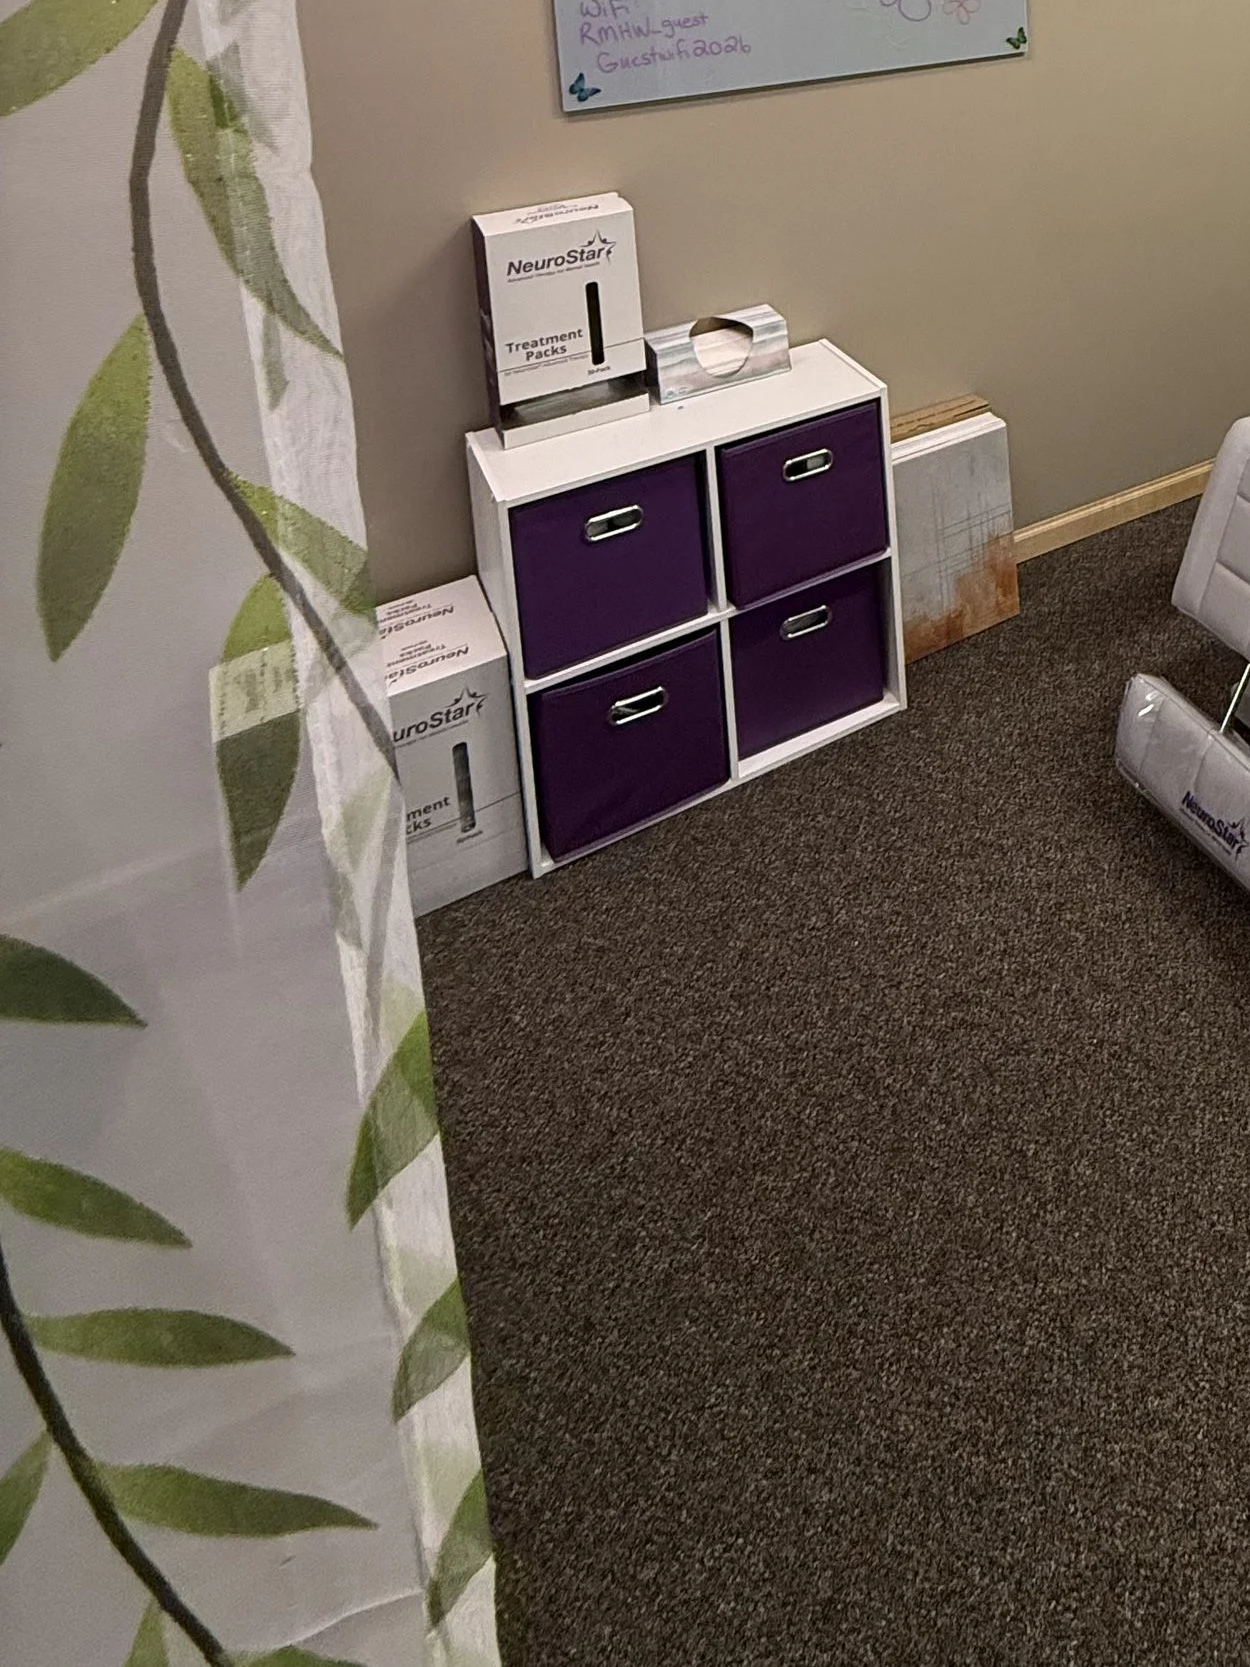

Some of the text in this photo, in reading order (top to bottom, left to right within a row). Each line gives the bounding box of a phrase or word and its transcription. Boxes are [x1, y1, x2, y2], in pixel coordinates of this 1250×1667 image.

[506, 247, 606, 276] NeuroStar
[505, 328, 583, 354] Treatment
[525, 345, 567, 362] Packs
[379, 605, 455, 635] NeuroSta
[393, 701, 476, 743] uroStar
[1182, 790, 1240, 850] NeuroStar
